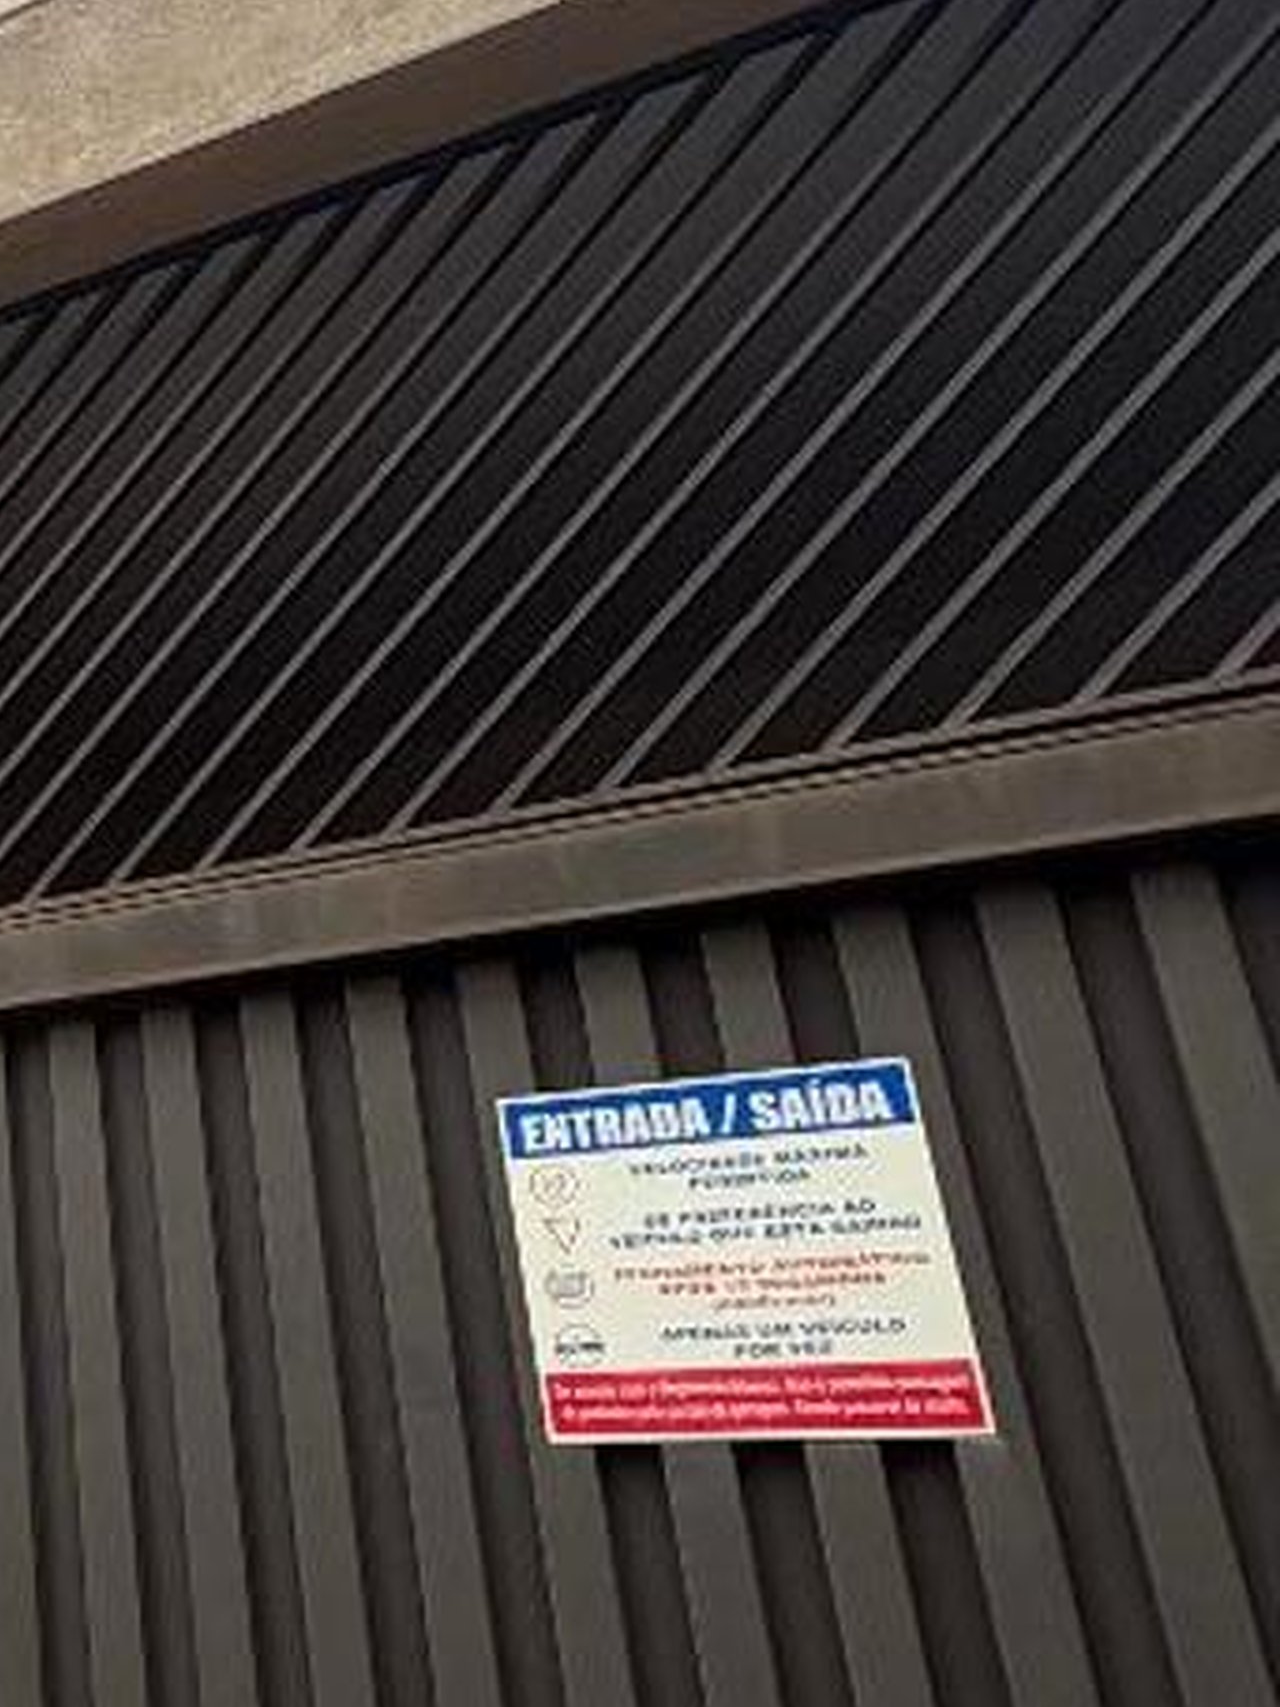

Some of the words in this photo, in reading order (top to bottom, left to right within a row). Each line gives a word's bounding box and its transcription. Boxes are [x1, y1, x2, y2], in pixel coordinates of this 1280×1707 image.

[520, 1099, 710, 1153] ENTRADA
[720, 1095, 736, 1134] /
[751, 1079, 895, 1130] SAÍDA
